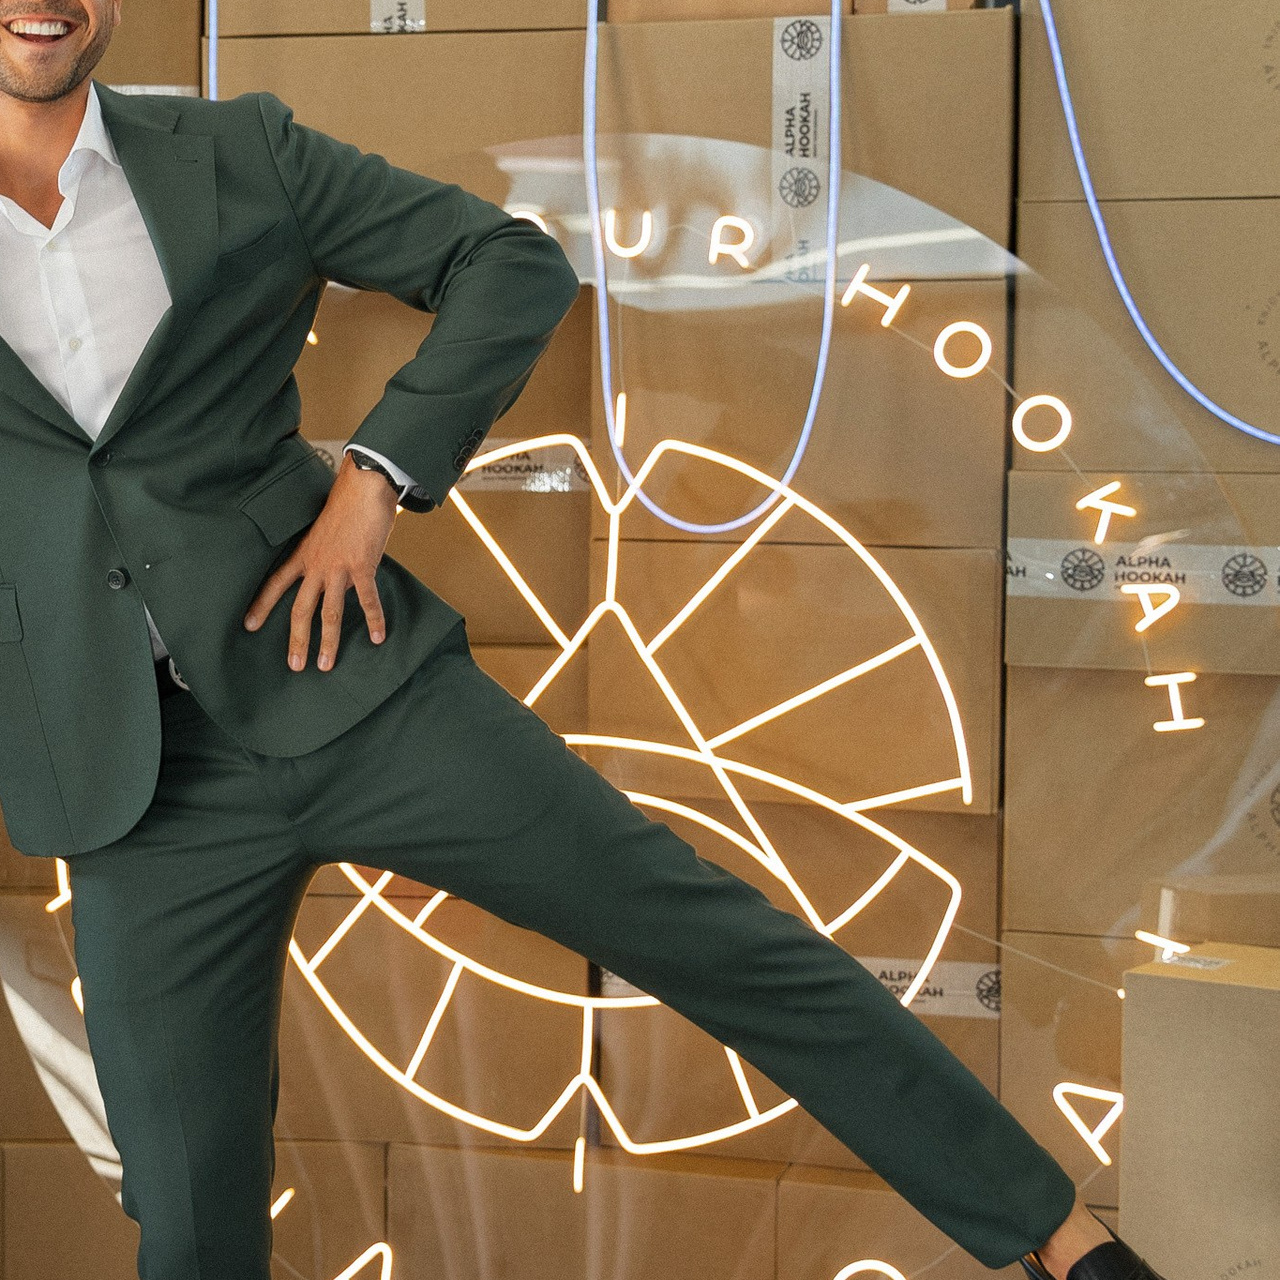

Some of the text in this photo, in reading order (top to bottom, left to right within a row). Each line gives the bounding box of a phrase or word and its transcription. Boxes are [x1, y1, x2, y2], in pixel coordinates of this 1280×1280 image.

[785, 106, 797, 157] ALPHA
[799, 92, 811, 158] HOOKAH
[1114, 570, 1187, 585] HOOKAH
[1116, 555, 1172, 569] ALPHA
